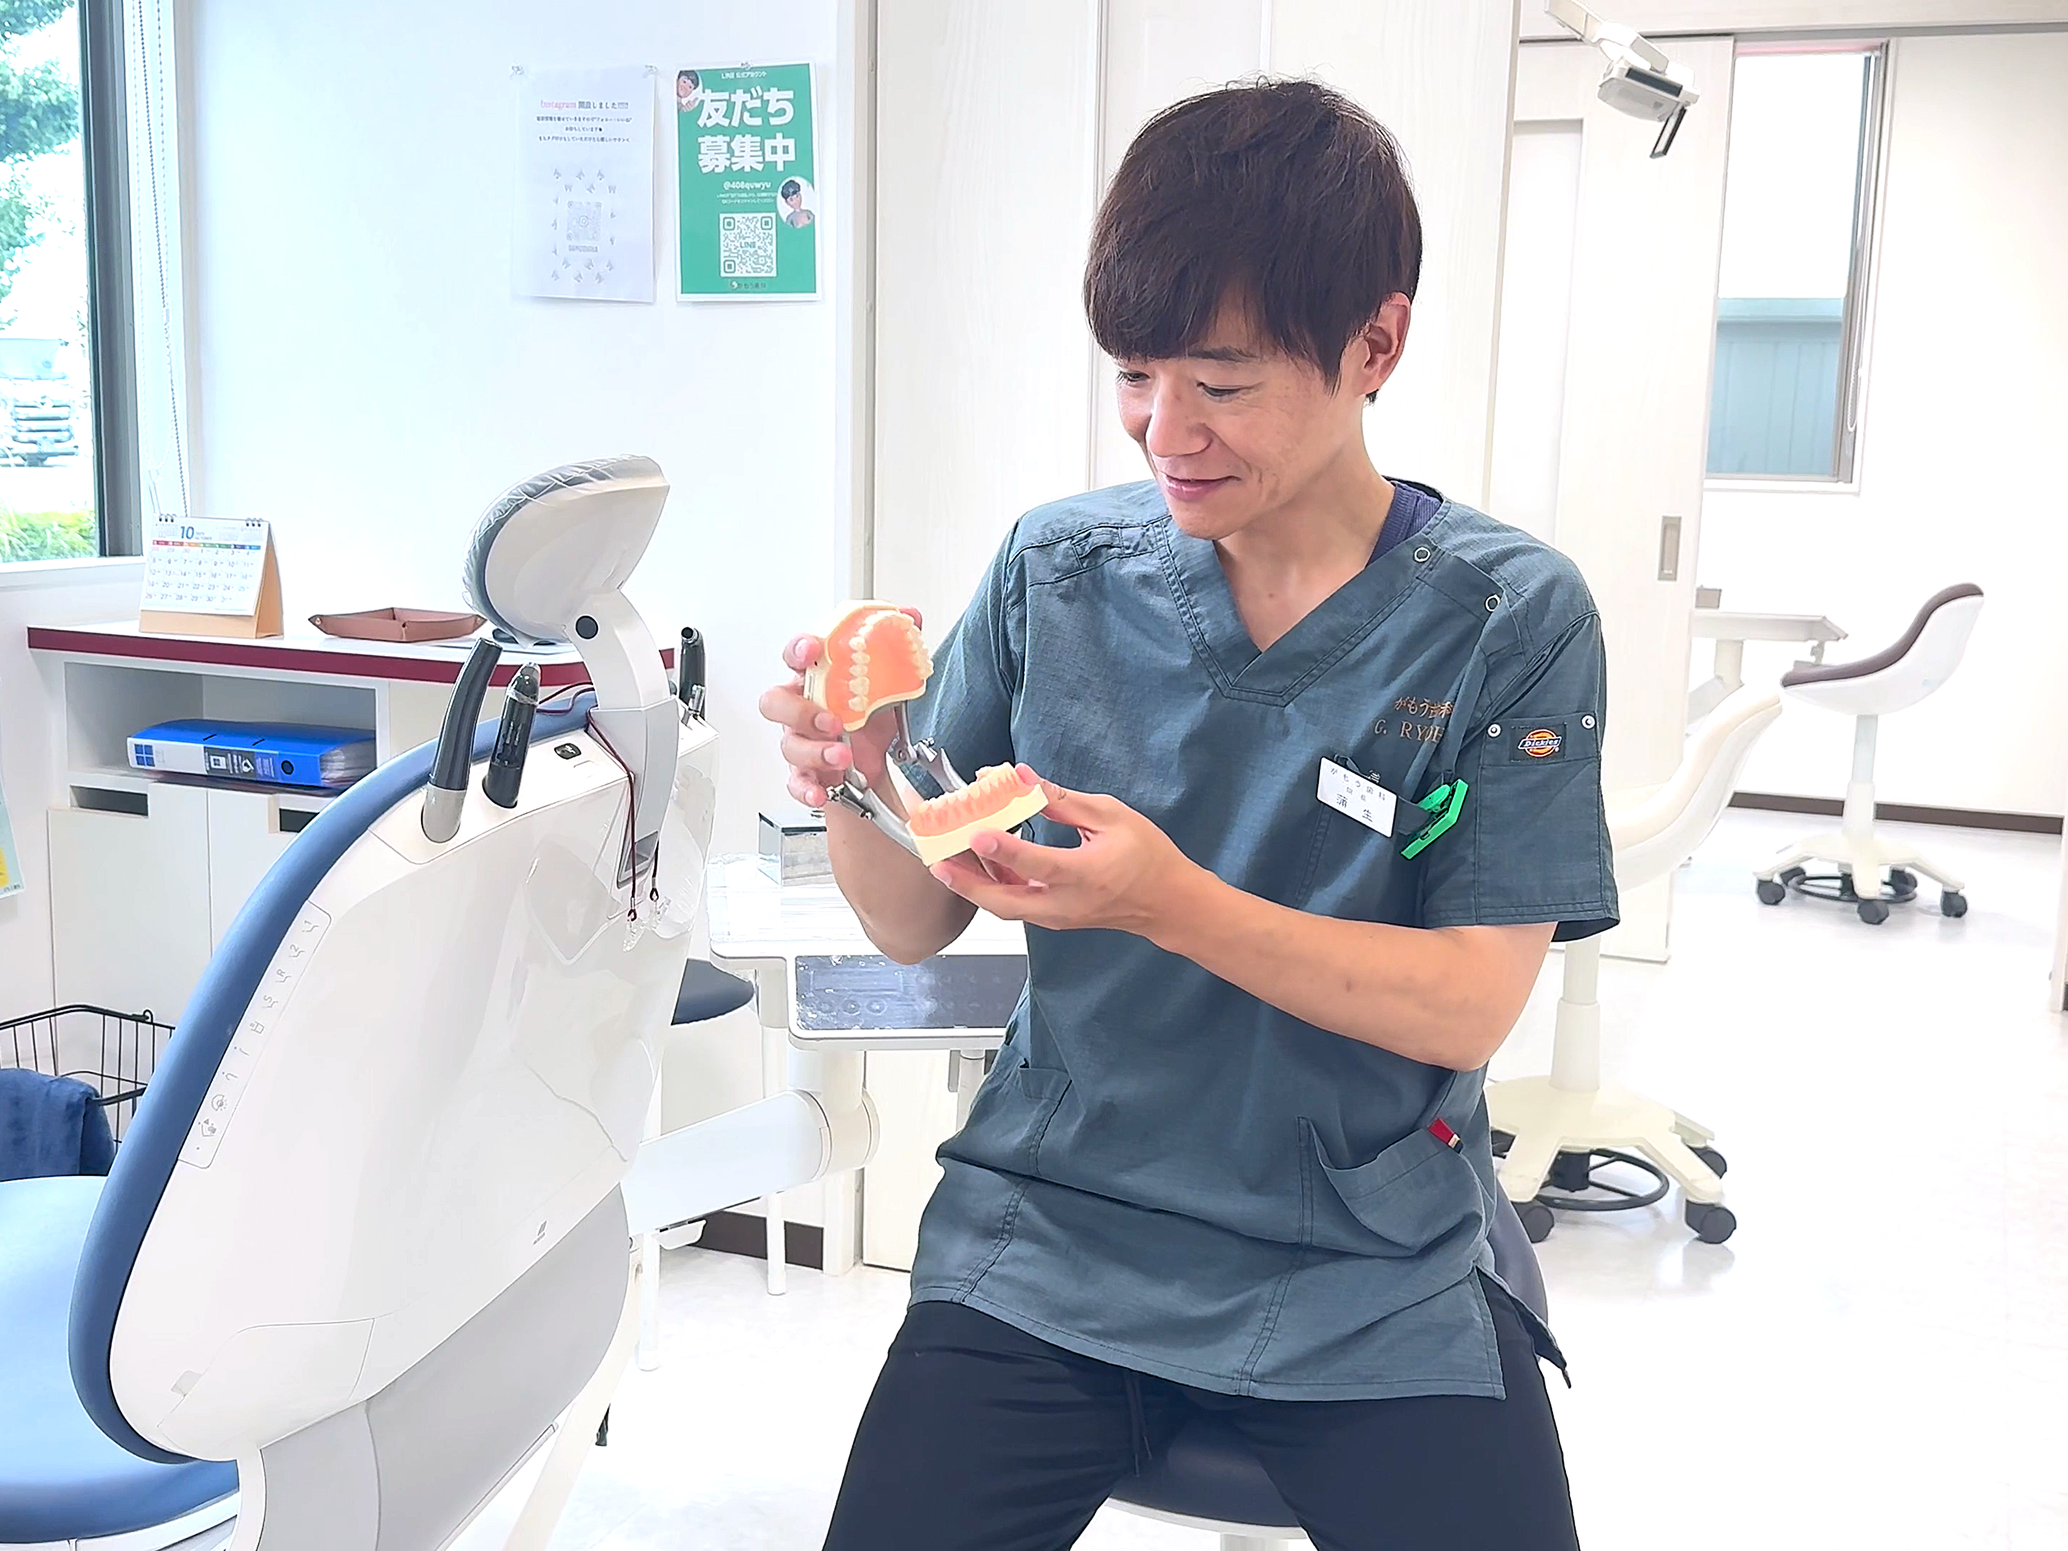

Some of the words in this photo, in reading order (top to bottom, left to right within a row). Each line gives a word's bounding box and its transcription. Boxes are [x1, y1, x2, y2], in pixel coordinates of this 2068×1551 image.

[697, 86, 794, 128] 友だち
[698, 132, 795, 174] 募集中
[180, 526, 194, 540] 10
[1524, 739, 1558, 747] Dickies
[290, 944, 299, 952] 2
[276, 968, 286, 977] R
[264, 995, 272, 1003] S
